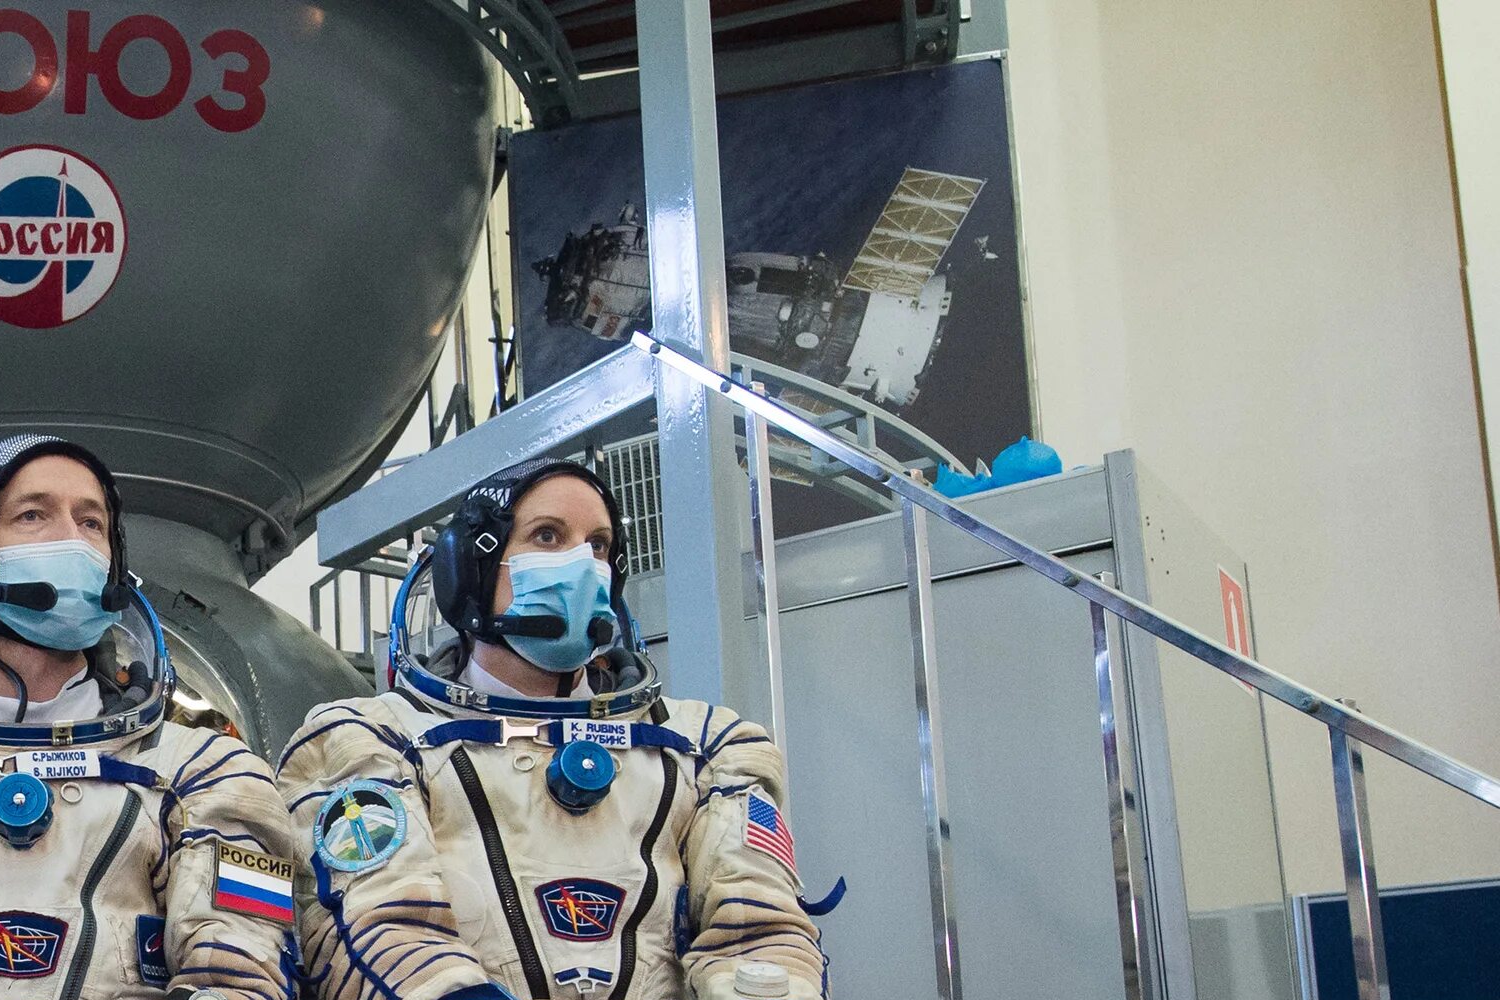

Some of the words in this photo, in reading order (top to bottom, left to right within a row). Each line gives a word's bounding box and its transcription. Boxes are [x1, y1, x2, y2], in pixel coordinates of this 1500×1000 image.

[571, 722, 582, 732] K.
[586, 723, 626, 735] RUBINS
[585, 733, 627, 745] РУБИНС
[33, 767, 43, 777] S.
[45, 766, 87, 777] RIJIKOV
[220, 845, 293, 878] РОССИЯ
